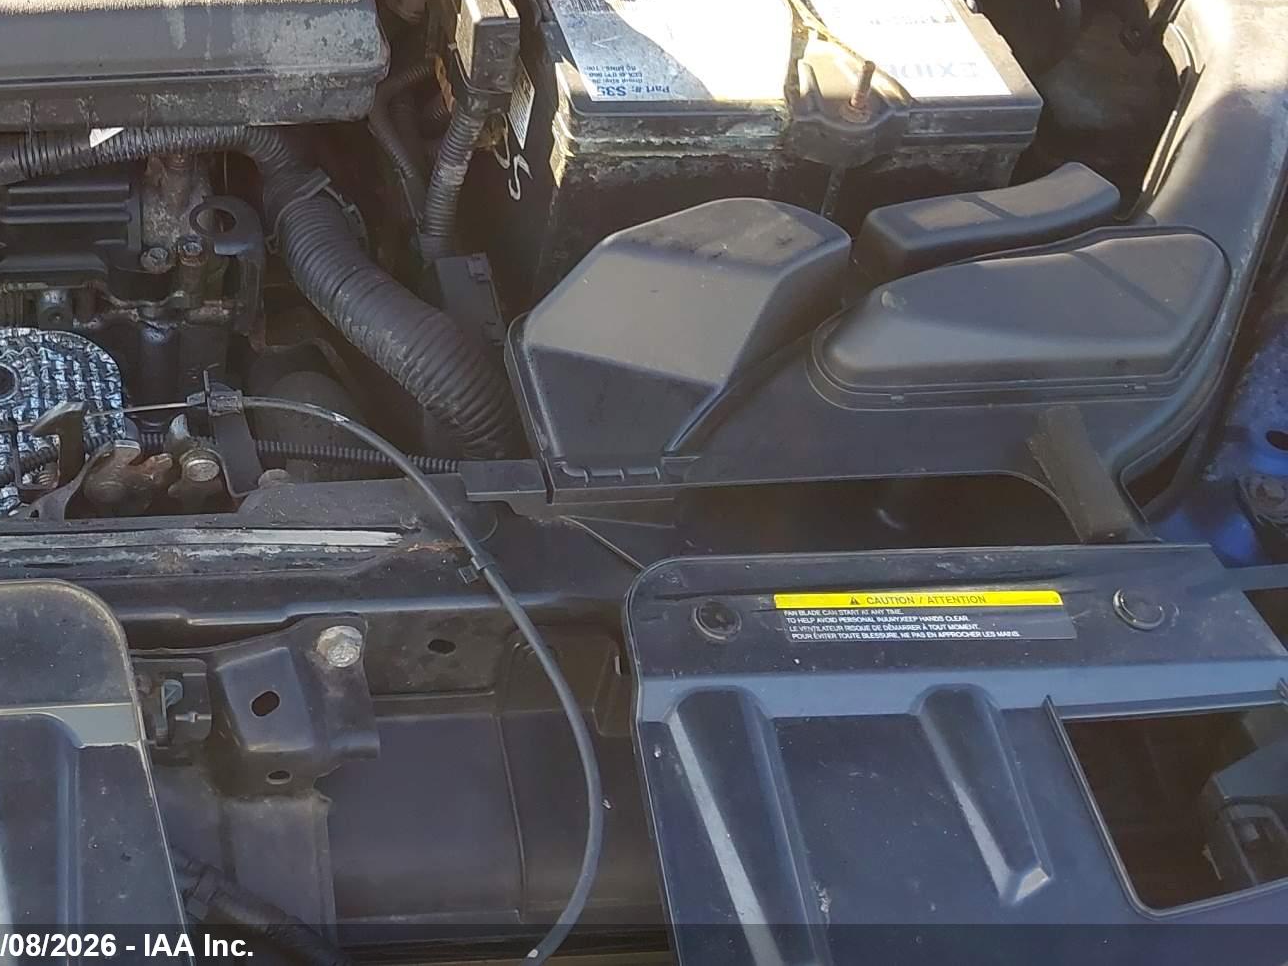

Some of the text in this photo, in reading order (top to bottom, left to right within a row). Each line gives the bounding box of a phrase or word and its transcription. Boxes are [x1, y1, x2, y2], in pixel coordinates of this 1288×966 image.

[646, 85, 670, 94] Part
[866, 596, 915, 605] CAUTION
[927, 595, 986, 604] ATTENTION
[882, 623, 921, 631] DÉMARRER
